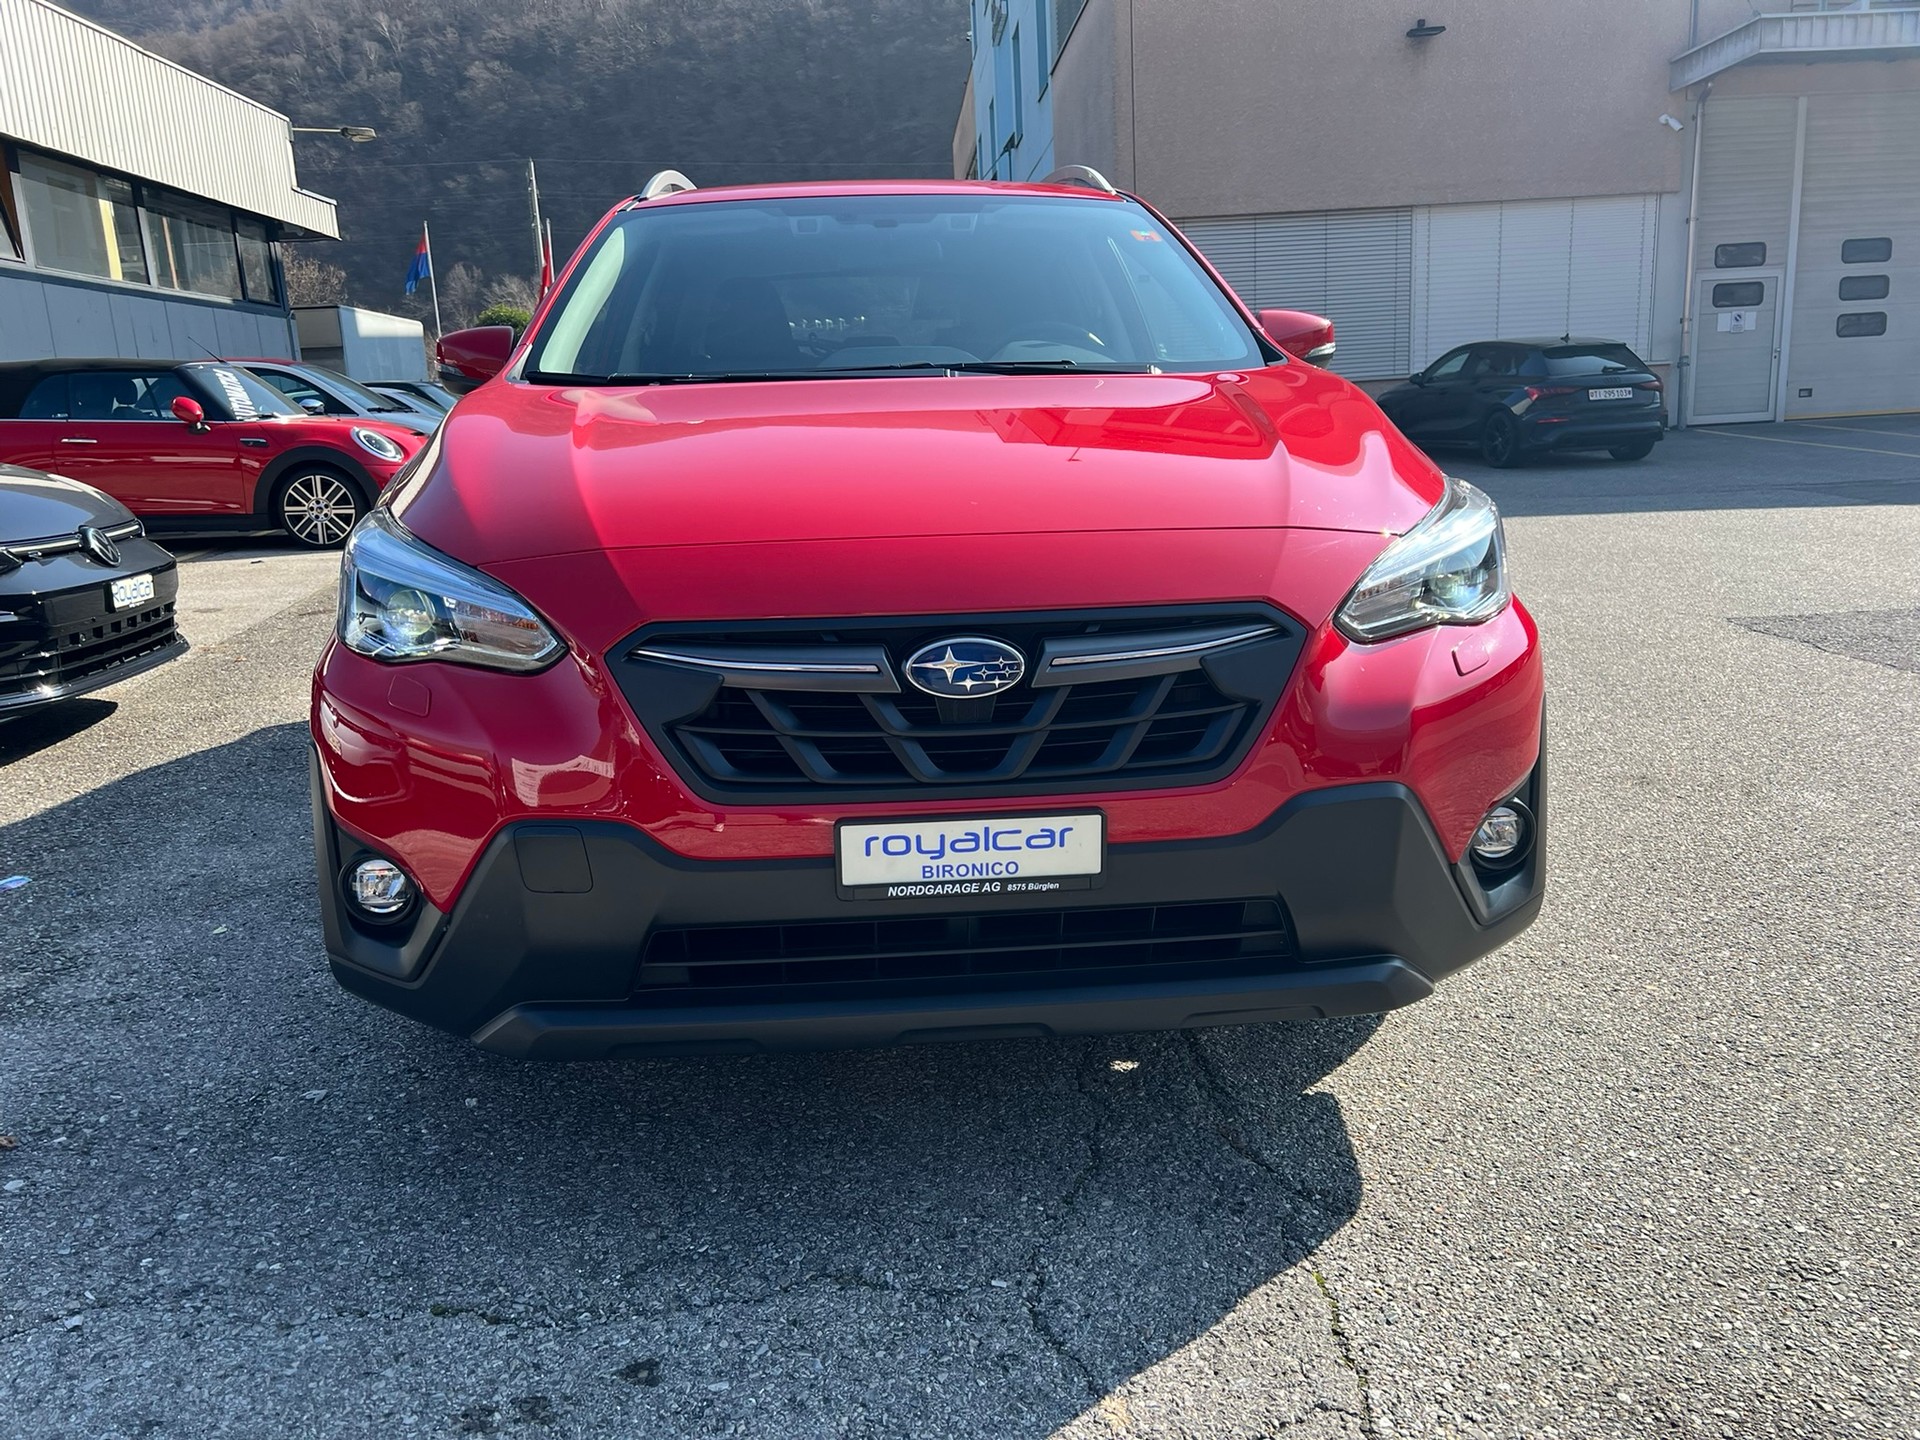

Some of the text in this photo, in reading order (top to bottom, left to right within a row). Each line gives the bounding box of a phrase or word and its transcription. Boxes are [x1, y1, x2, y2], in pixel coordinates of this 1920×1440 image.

[922, 861, 1019, 879] BIRONICO
[888, 883, 980, 897] NORDGARAGE
[982, 882, 1001, 892] AG
[1028, 883, 1059, 892] Bürglen
